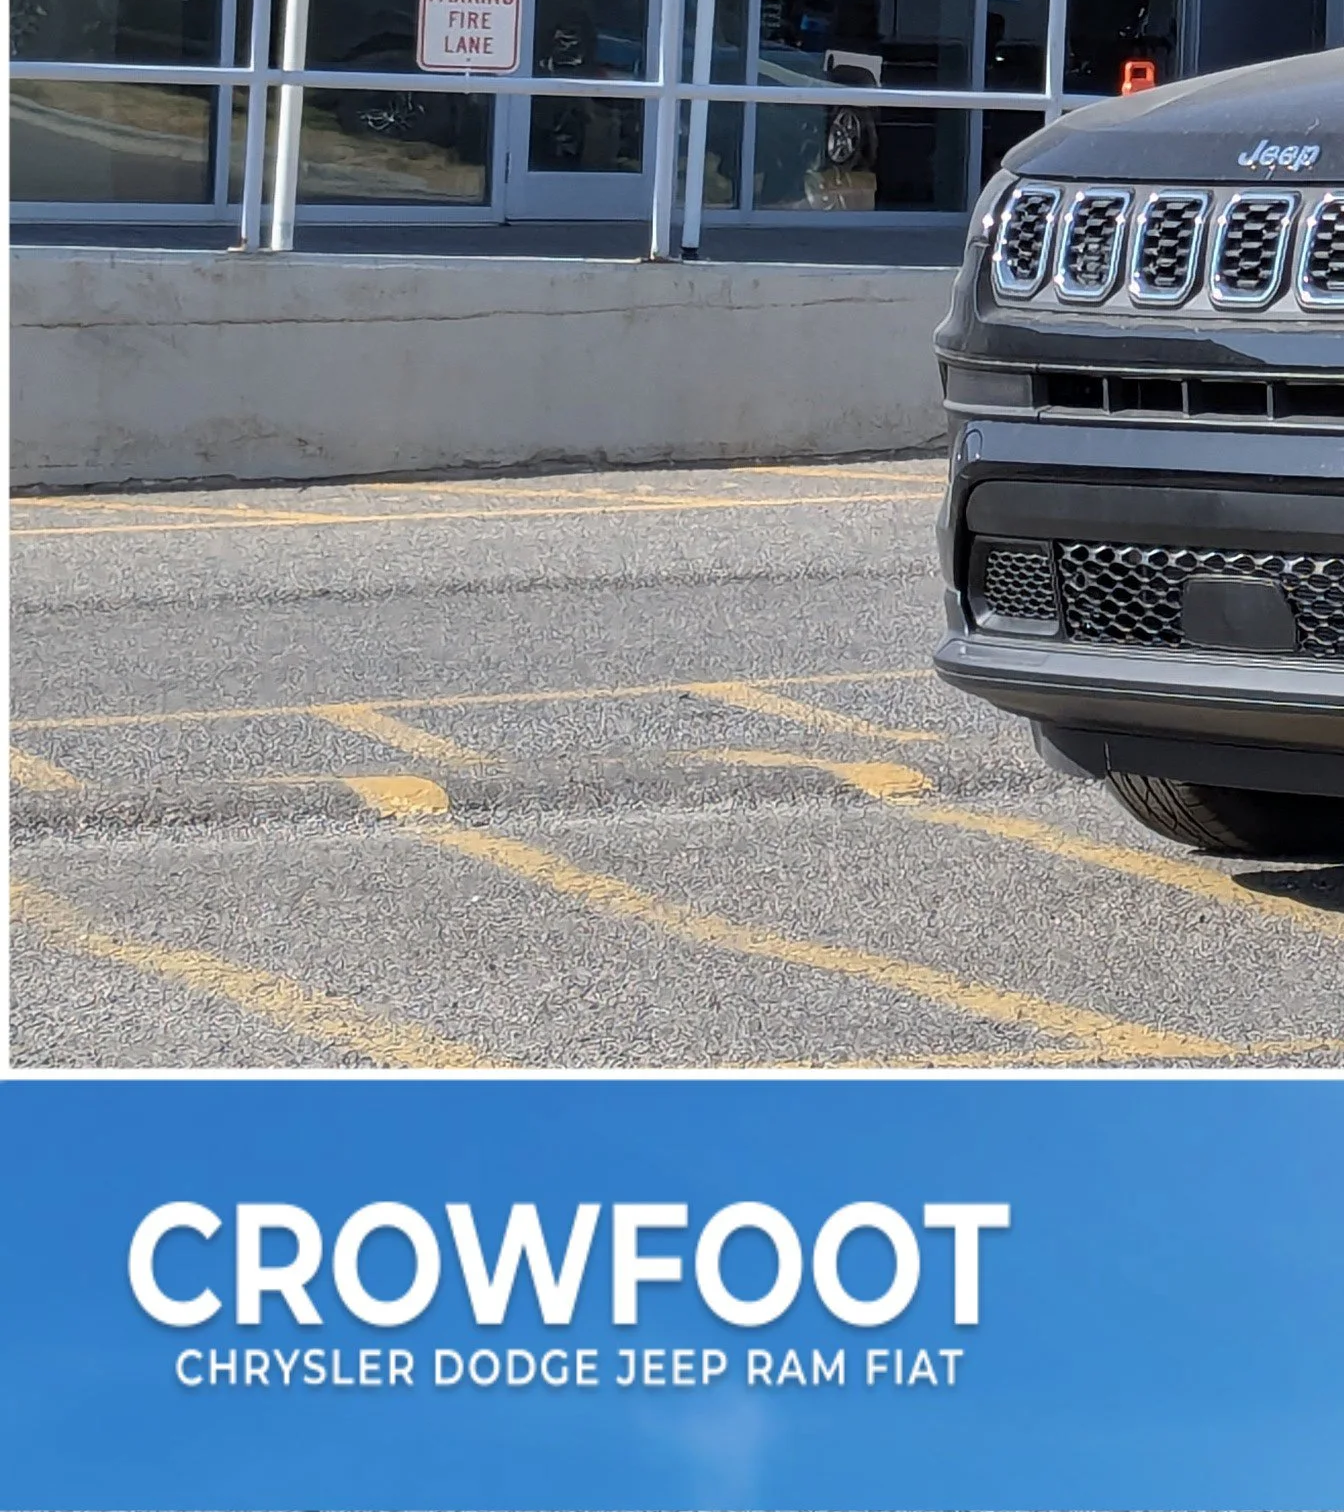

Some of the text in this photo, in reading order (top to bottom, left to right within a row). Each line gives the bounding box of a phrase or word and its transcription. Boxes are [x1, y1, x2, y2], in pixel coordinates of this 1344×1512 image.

[448, 10, 492, 29] FIRE
[444, 35, 494, 55] LANE
[1237, 139, 1321, 172] Jeep
